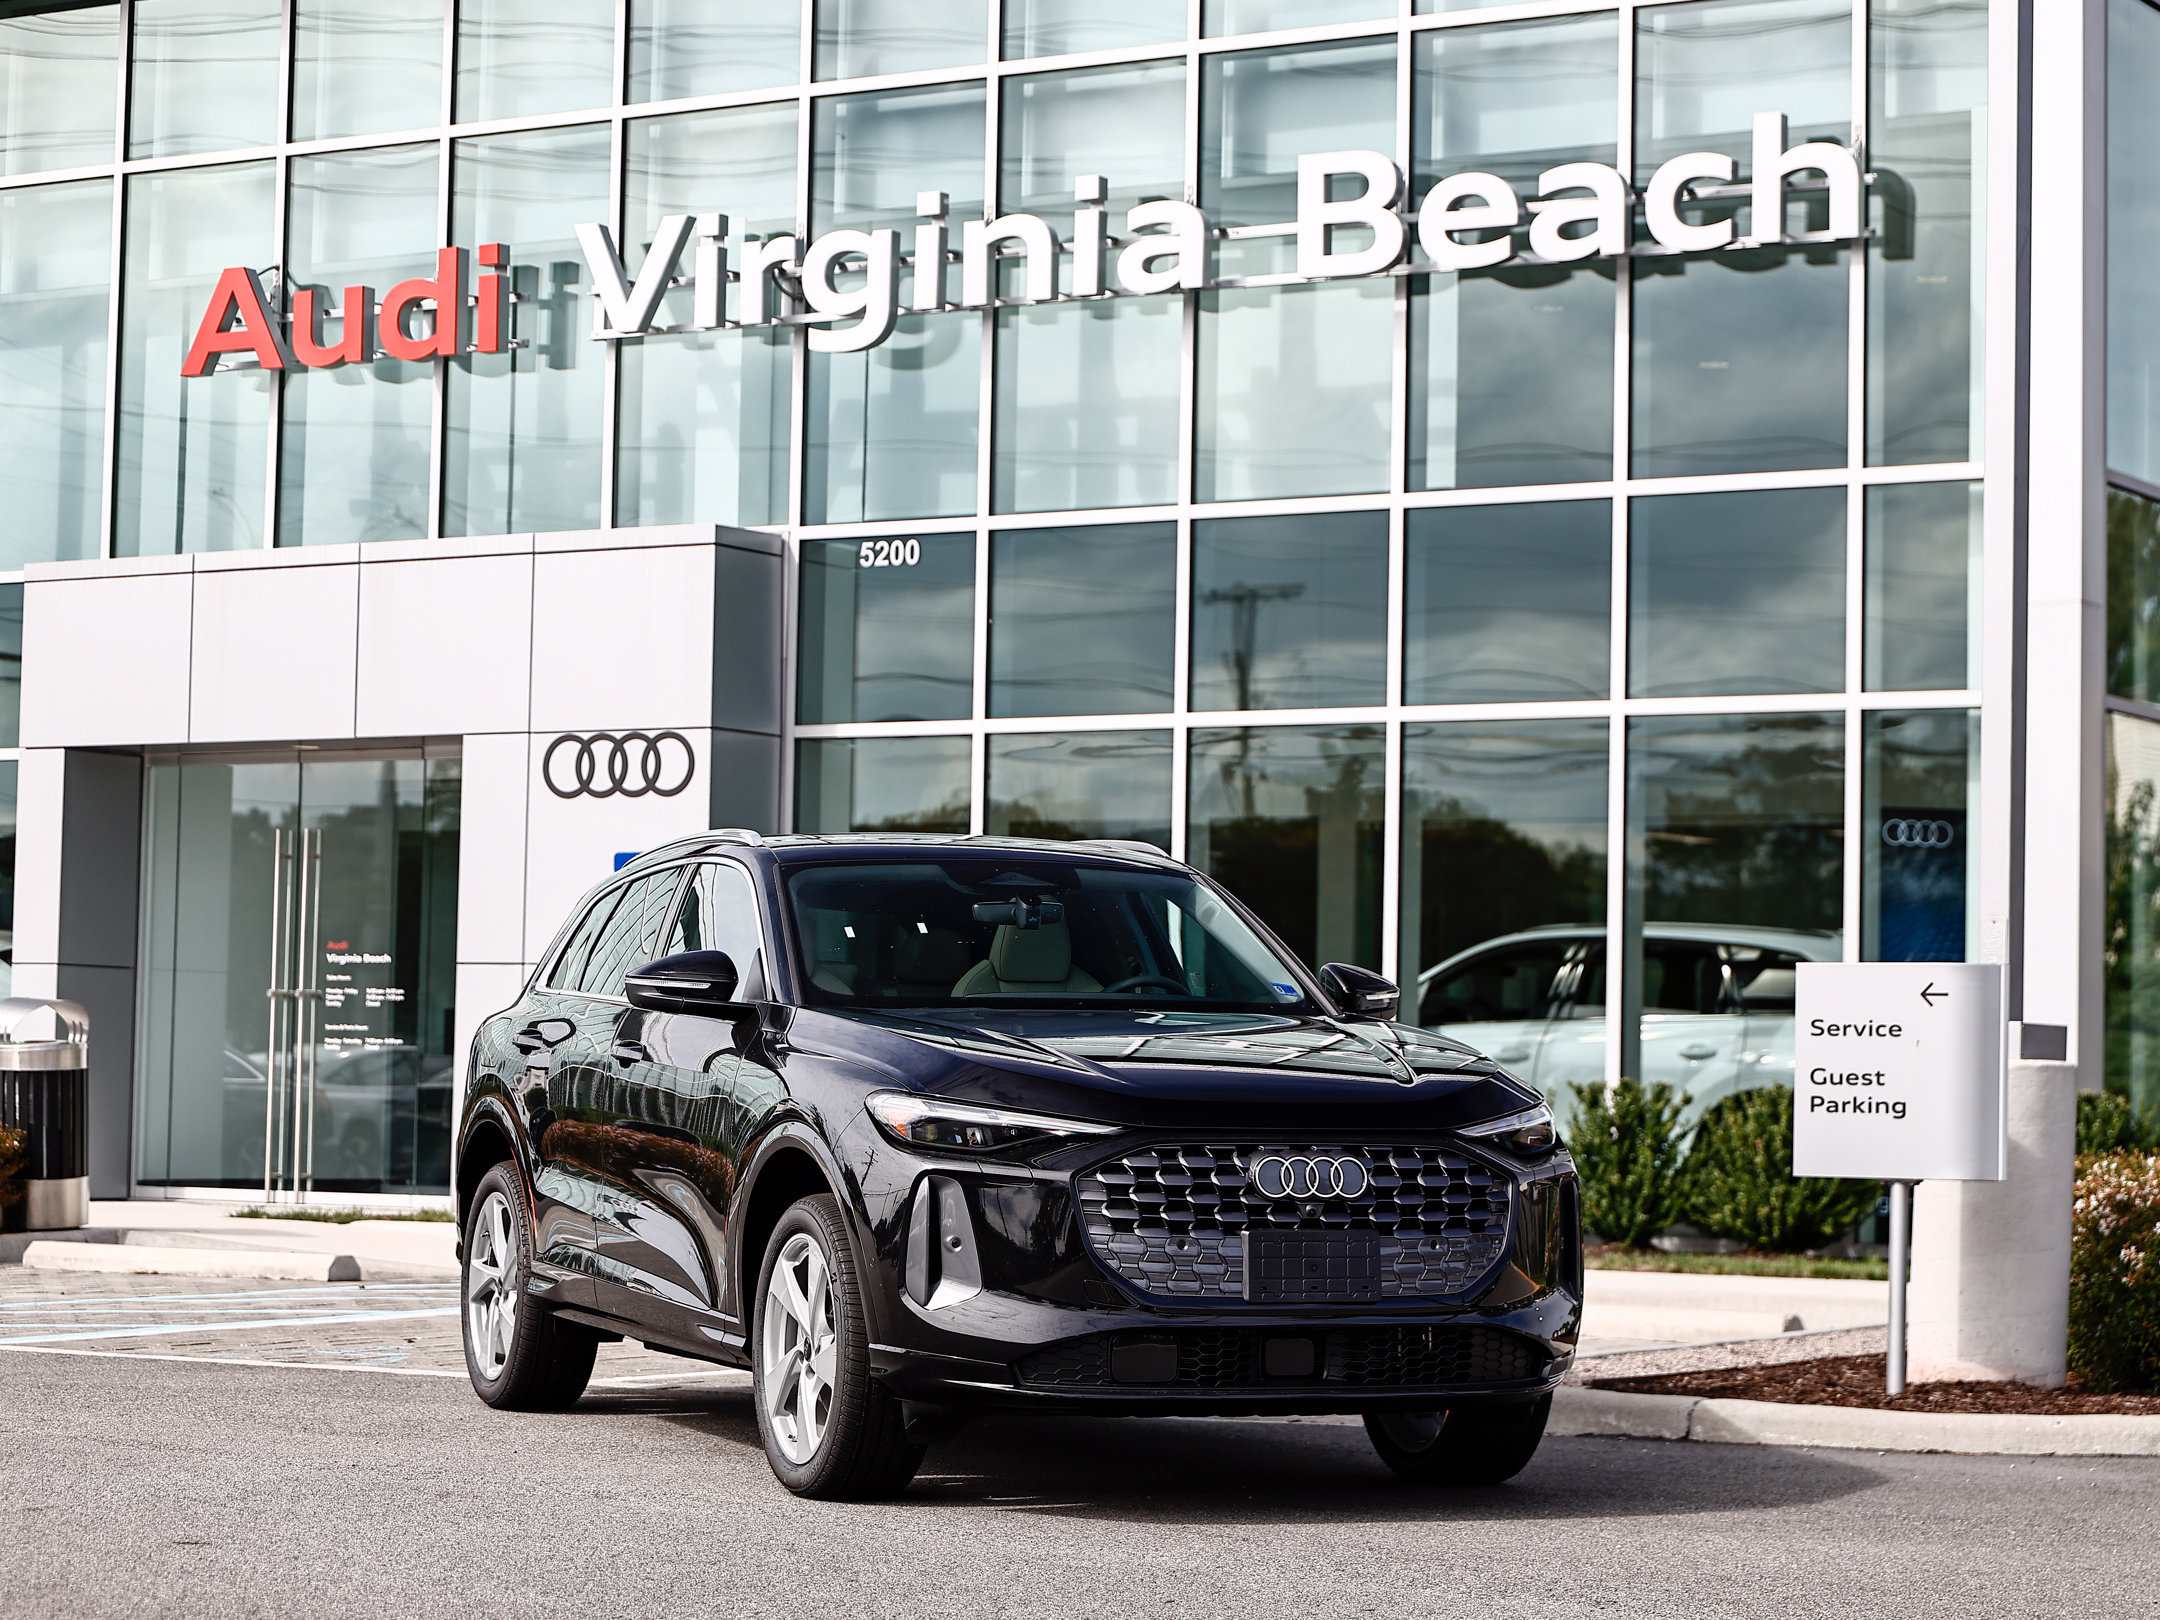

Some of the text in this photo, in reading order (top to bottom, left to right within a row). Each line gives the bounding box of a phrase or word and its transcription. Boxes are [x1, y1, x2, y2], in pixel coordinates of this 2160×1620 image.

[181, 112, 1868, 378] Audi Virginia Beach
[859, 538, 921, 568] 5200
[1809, 1018, 1903, 1037] Service
[1809, 1067, 1886, 1086] Guest
[1809, 1095, 1907, 1119] Parking
